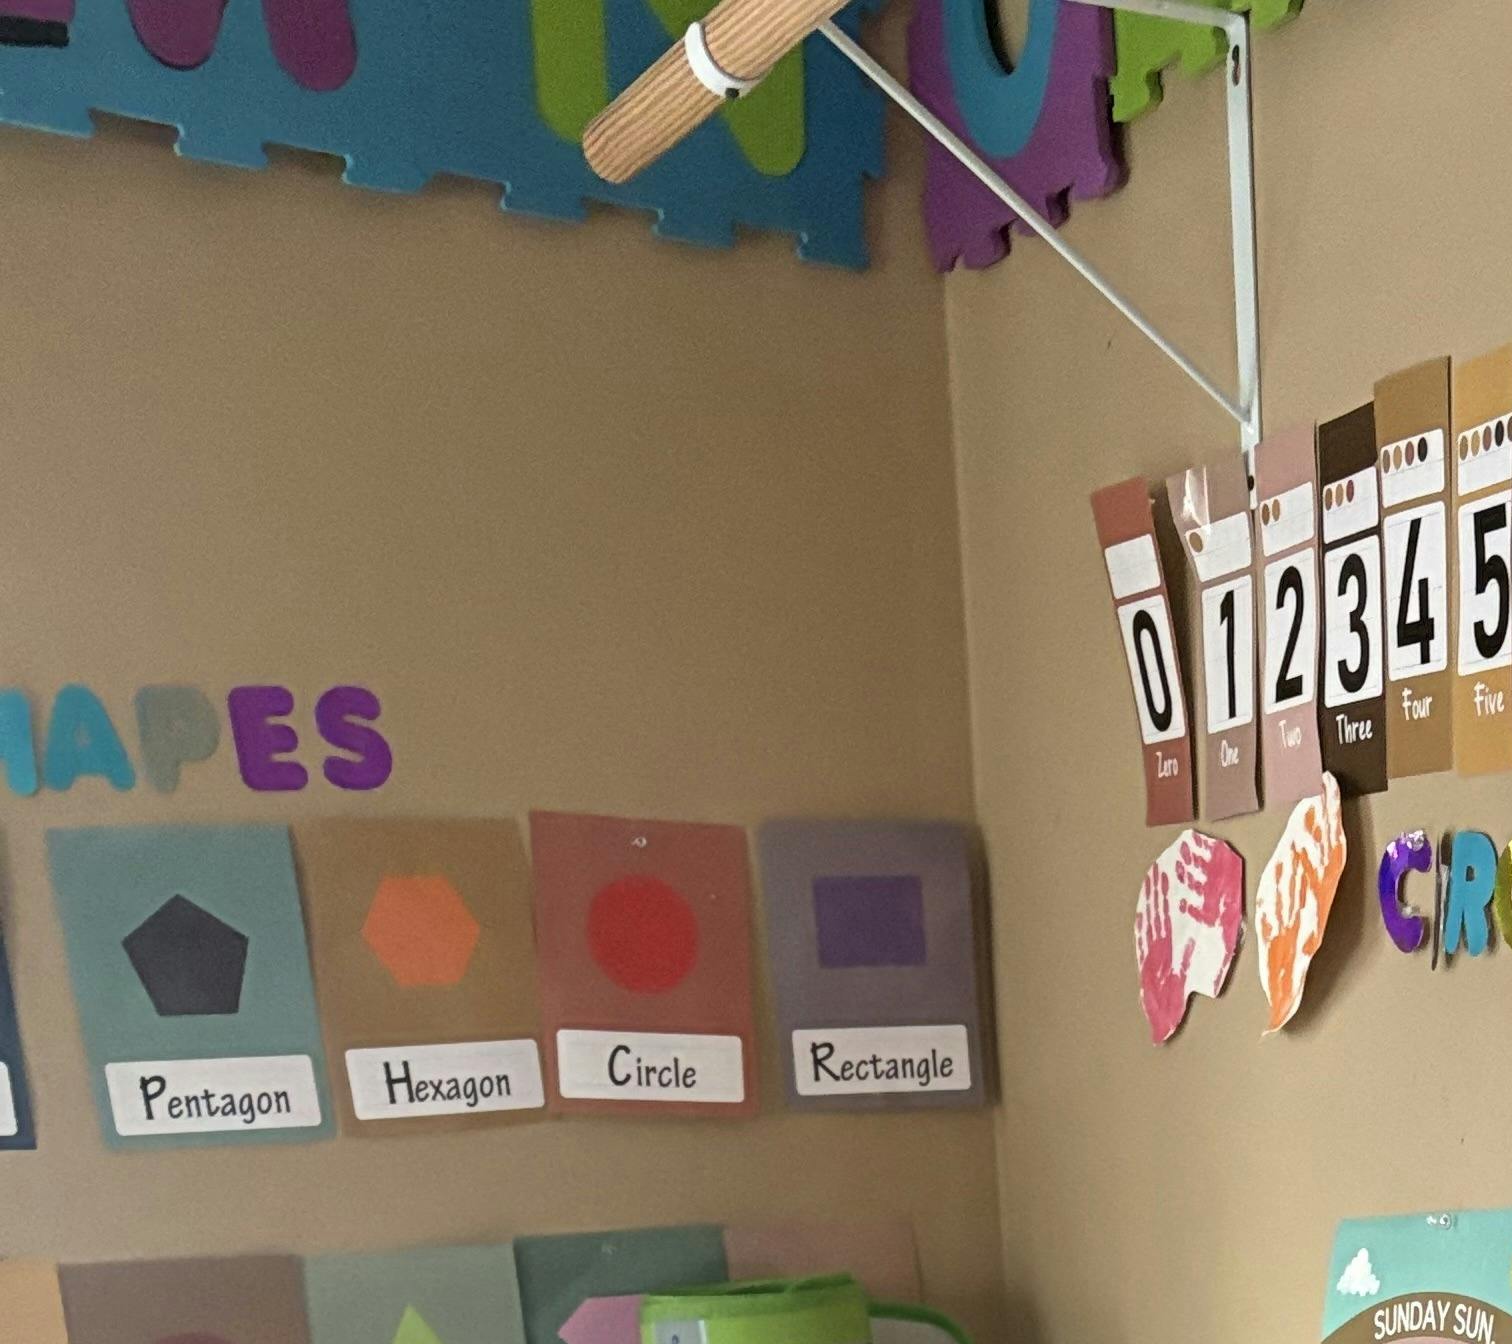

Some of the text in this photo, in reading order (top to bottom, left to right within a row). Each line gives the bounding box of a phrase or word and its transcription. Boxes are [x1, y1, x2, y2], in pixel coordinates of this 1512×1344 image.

[1397, 518, 1434, 665] 4
[1472, 504, 1509, 659] 5
[1275, 566, 1303, 703] 2
[1337, 553, 1370, 693] 3
[1133, 610, 1173, 732] 0
[1219, 590, 1237, 718] 1
[1402, 687, 1433, 720] Four
[1473, 681, 1505, 717] Five
[1279, 720, 1302, 748] Two
[1336, 715, 1373, 745] Three
[1157, 752, 1178, 778] Zero
[1220, 740, 1238, 767] One
[382, 1059, 511, 1108] Hexagon
[607, 1044, 696, 1089] Circle
[810, 1041, 954, 1086] Rectangle
[139, 1075, 291, 1124] Pentagon
[1374, 1300, 1451, 1340] SUNDAY
